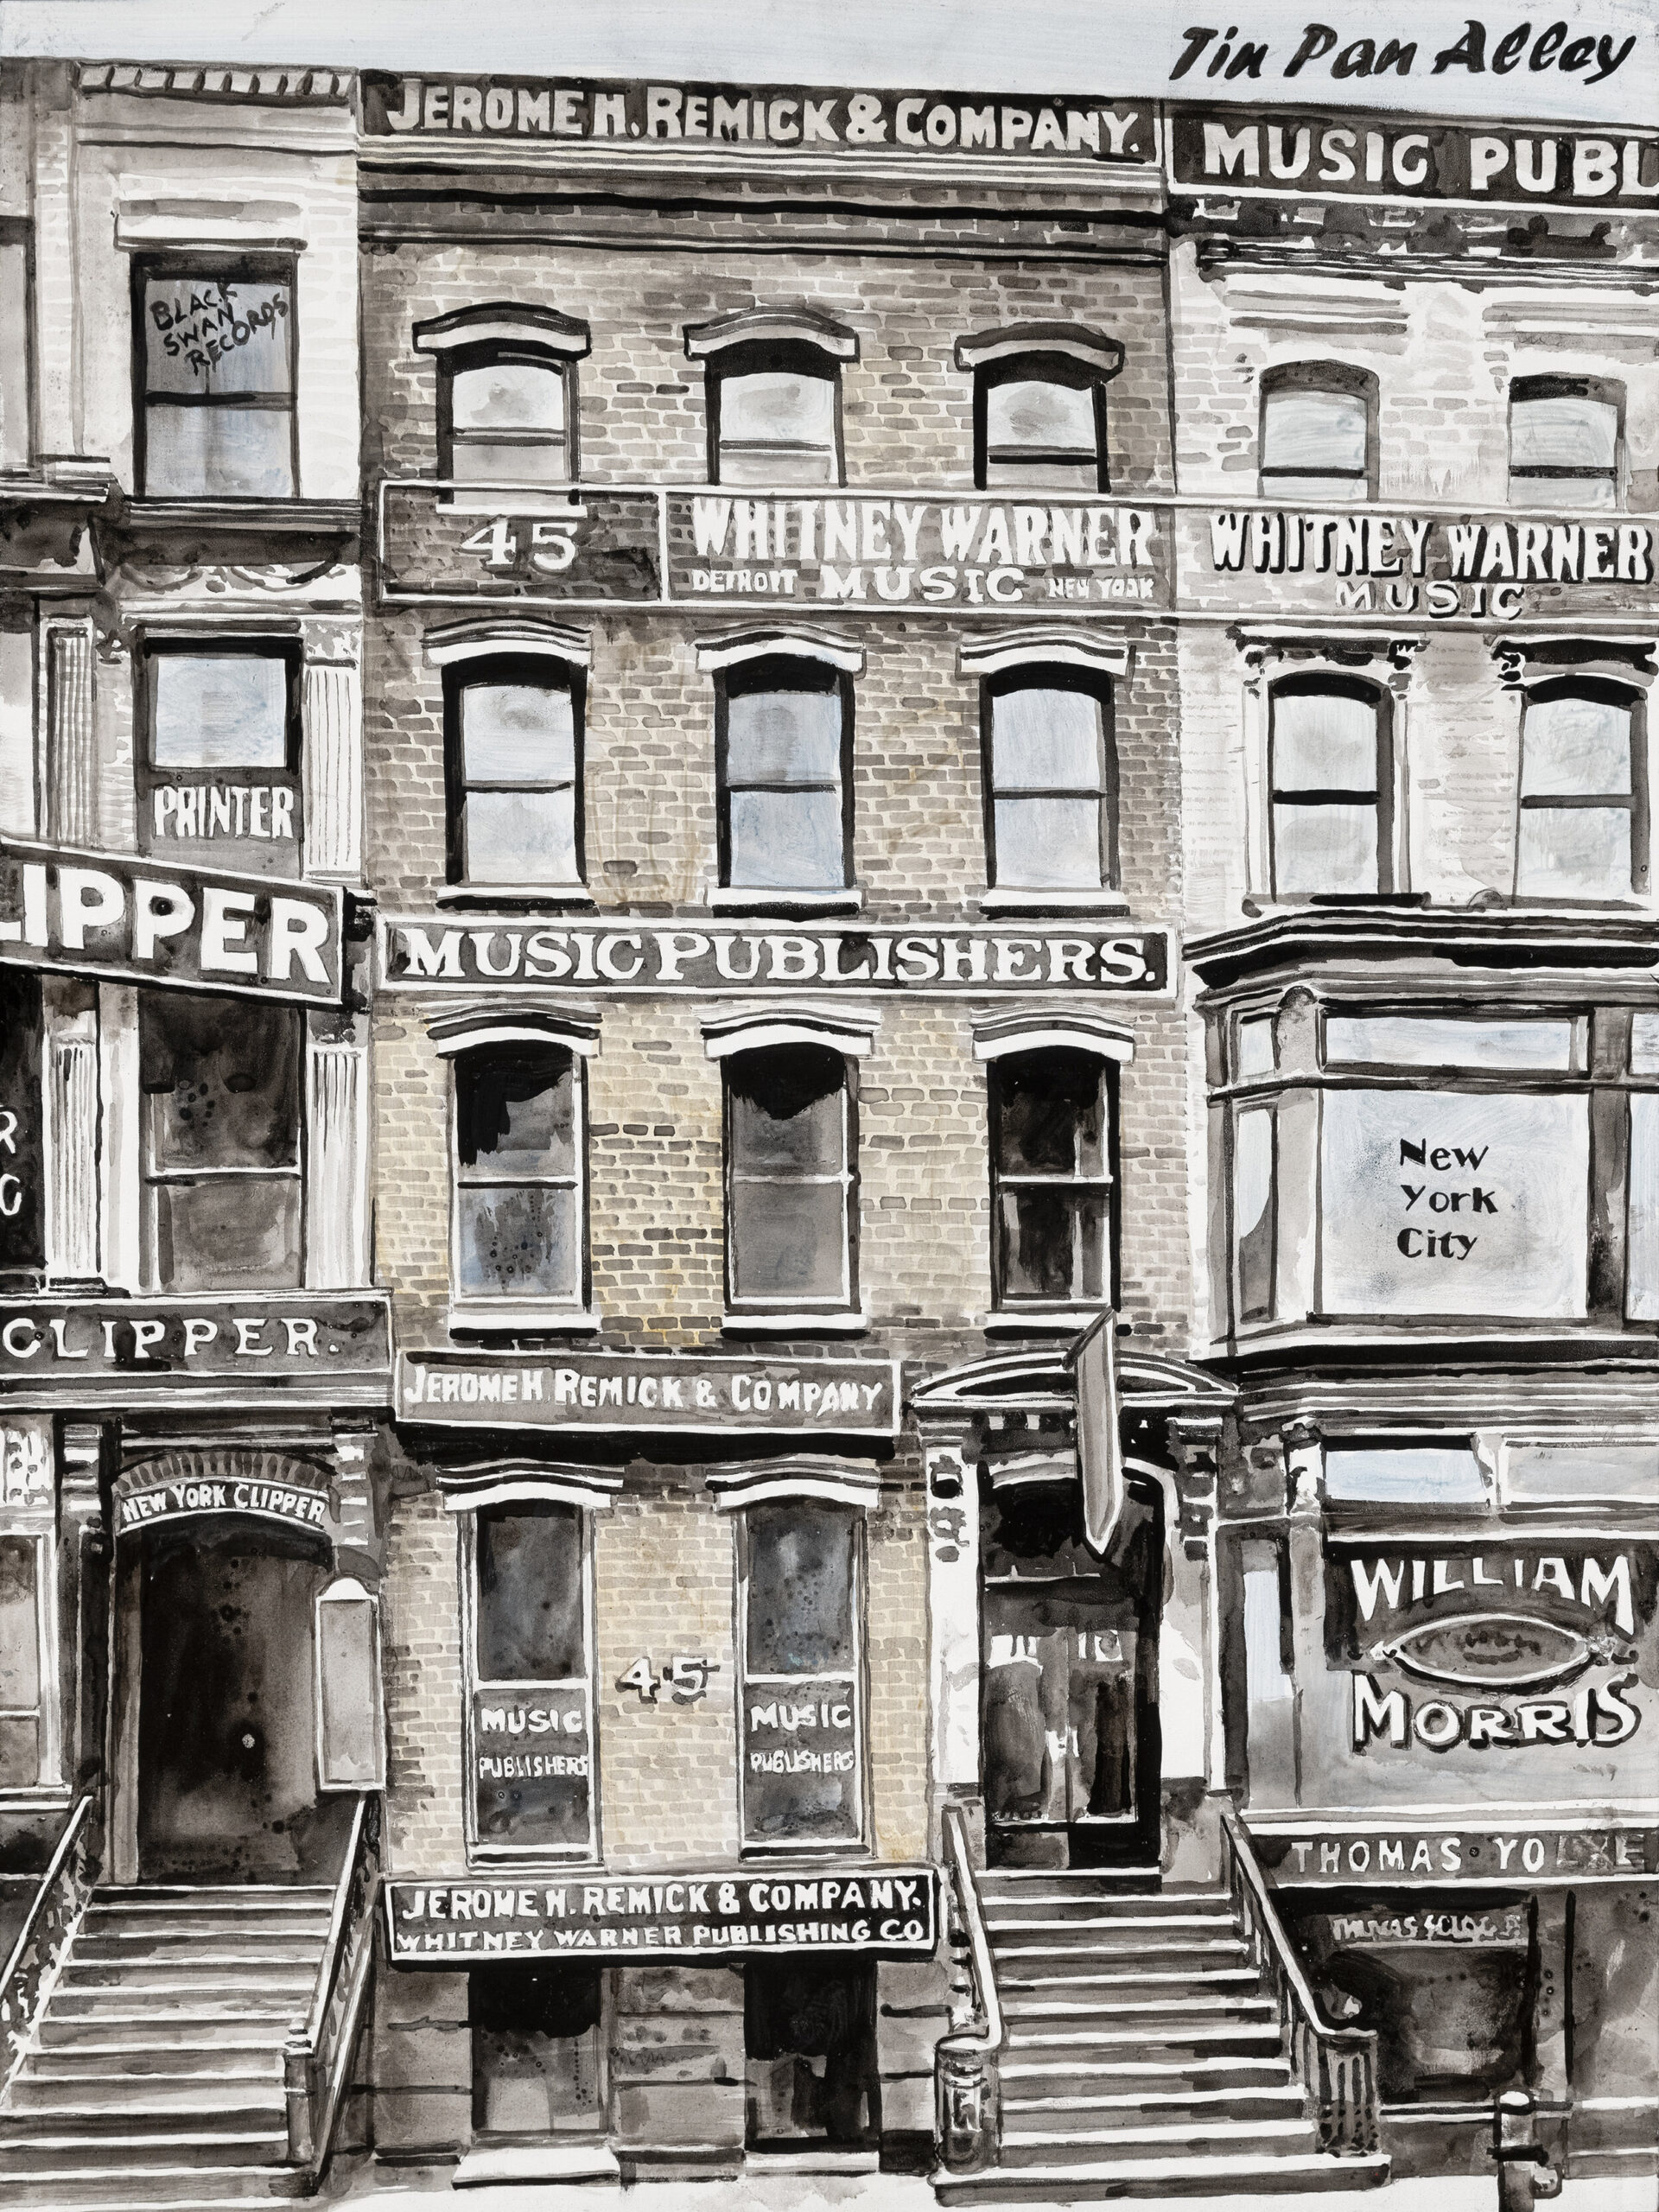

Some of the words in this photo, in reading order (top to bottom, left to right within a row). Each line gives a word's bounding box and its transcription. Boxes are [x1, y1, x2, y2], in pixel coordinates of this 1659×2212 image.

[1169, 26, 1268, 80] Tin
[1283, 23, 1418, 79] Pan
[1431, 20, 1637, 85] Alley
[387, 79, 586, 134] JEROME
[895, 98, 1139, 154] COMPANY.
[1204, 123, 1429, 186] MUSIC
[1470, 136, 1659, 196] PUBL
[149, 283, 238, 331] BLACK
[164, 302, 235, 356] SWAN
[460, 518, 579, 571] 45
[941, 505, 1155, 566] WARNER
[1209, 512, 1433, 579] WHITNEY
[1446, 521, 1652, 585] WARNER
[820, 564, 1026, 602] MUSIC
[1336, 580, 1526, 620] MUSIC
[153, 785, 295, 839] PRINTER
[398, 928, 645, 981] MUSIC
[652, 931, 1156, 984] PUBLISHERS.
[1400, 1137, 1490, 1172] New
[1400, 1184, 1499, 1214] York
[1396, 1227, 1478, 1261] City
[2, 1317, 340, 1359] CLIPPER.
[555, 1368, 685, 1408] REMICK
[696, 1376, 718, 1409] &
[731, 1375, 882, 1418] COMPANY
[123, 1494, 168, 1523] NEW
[172, 1484, 227, 1510] YORK
[232, 1484, 327, 1524] CLIPPER
[1351, 1554, 1635, 1635] WILLIAM
[614, 1653, 721, 1705] 45
[480, 1707, 582, 1734] MUSIC
[750, 1703, 852, 1732] MUSIC
[1351, 1671, 1642, 1754] MORRIS
[1291, 1837, 1462, 1873] THOMAS
[402, 1886, 540, 1920] JEROME
[583, 1884, 711, 1915] REMICK
[718, 1882, 741, 1914] &
[748, 1879, 921, 1912] COMPANY.
[397, 1929, 544, 1951] WHITNEY
[553, 1926, 682, 1947] WARNER
[693, 1919, 871, 1946] PUBLISHING
[880, 1919, 925, 1941] CO
